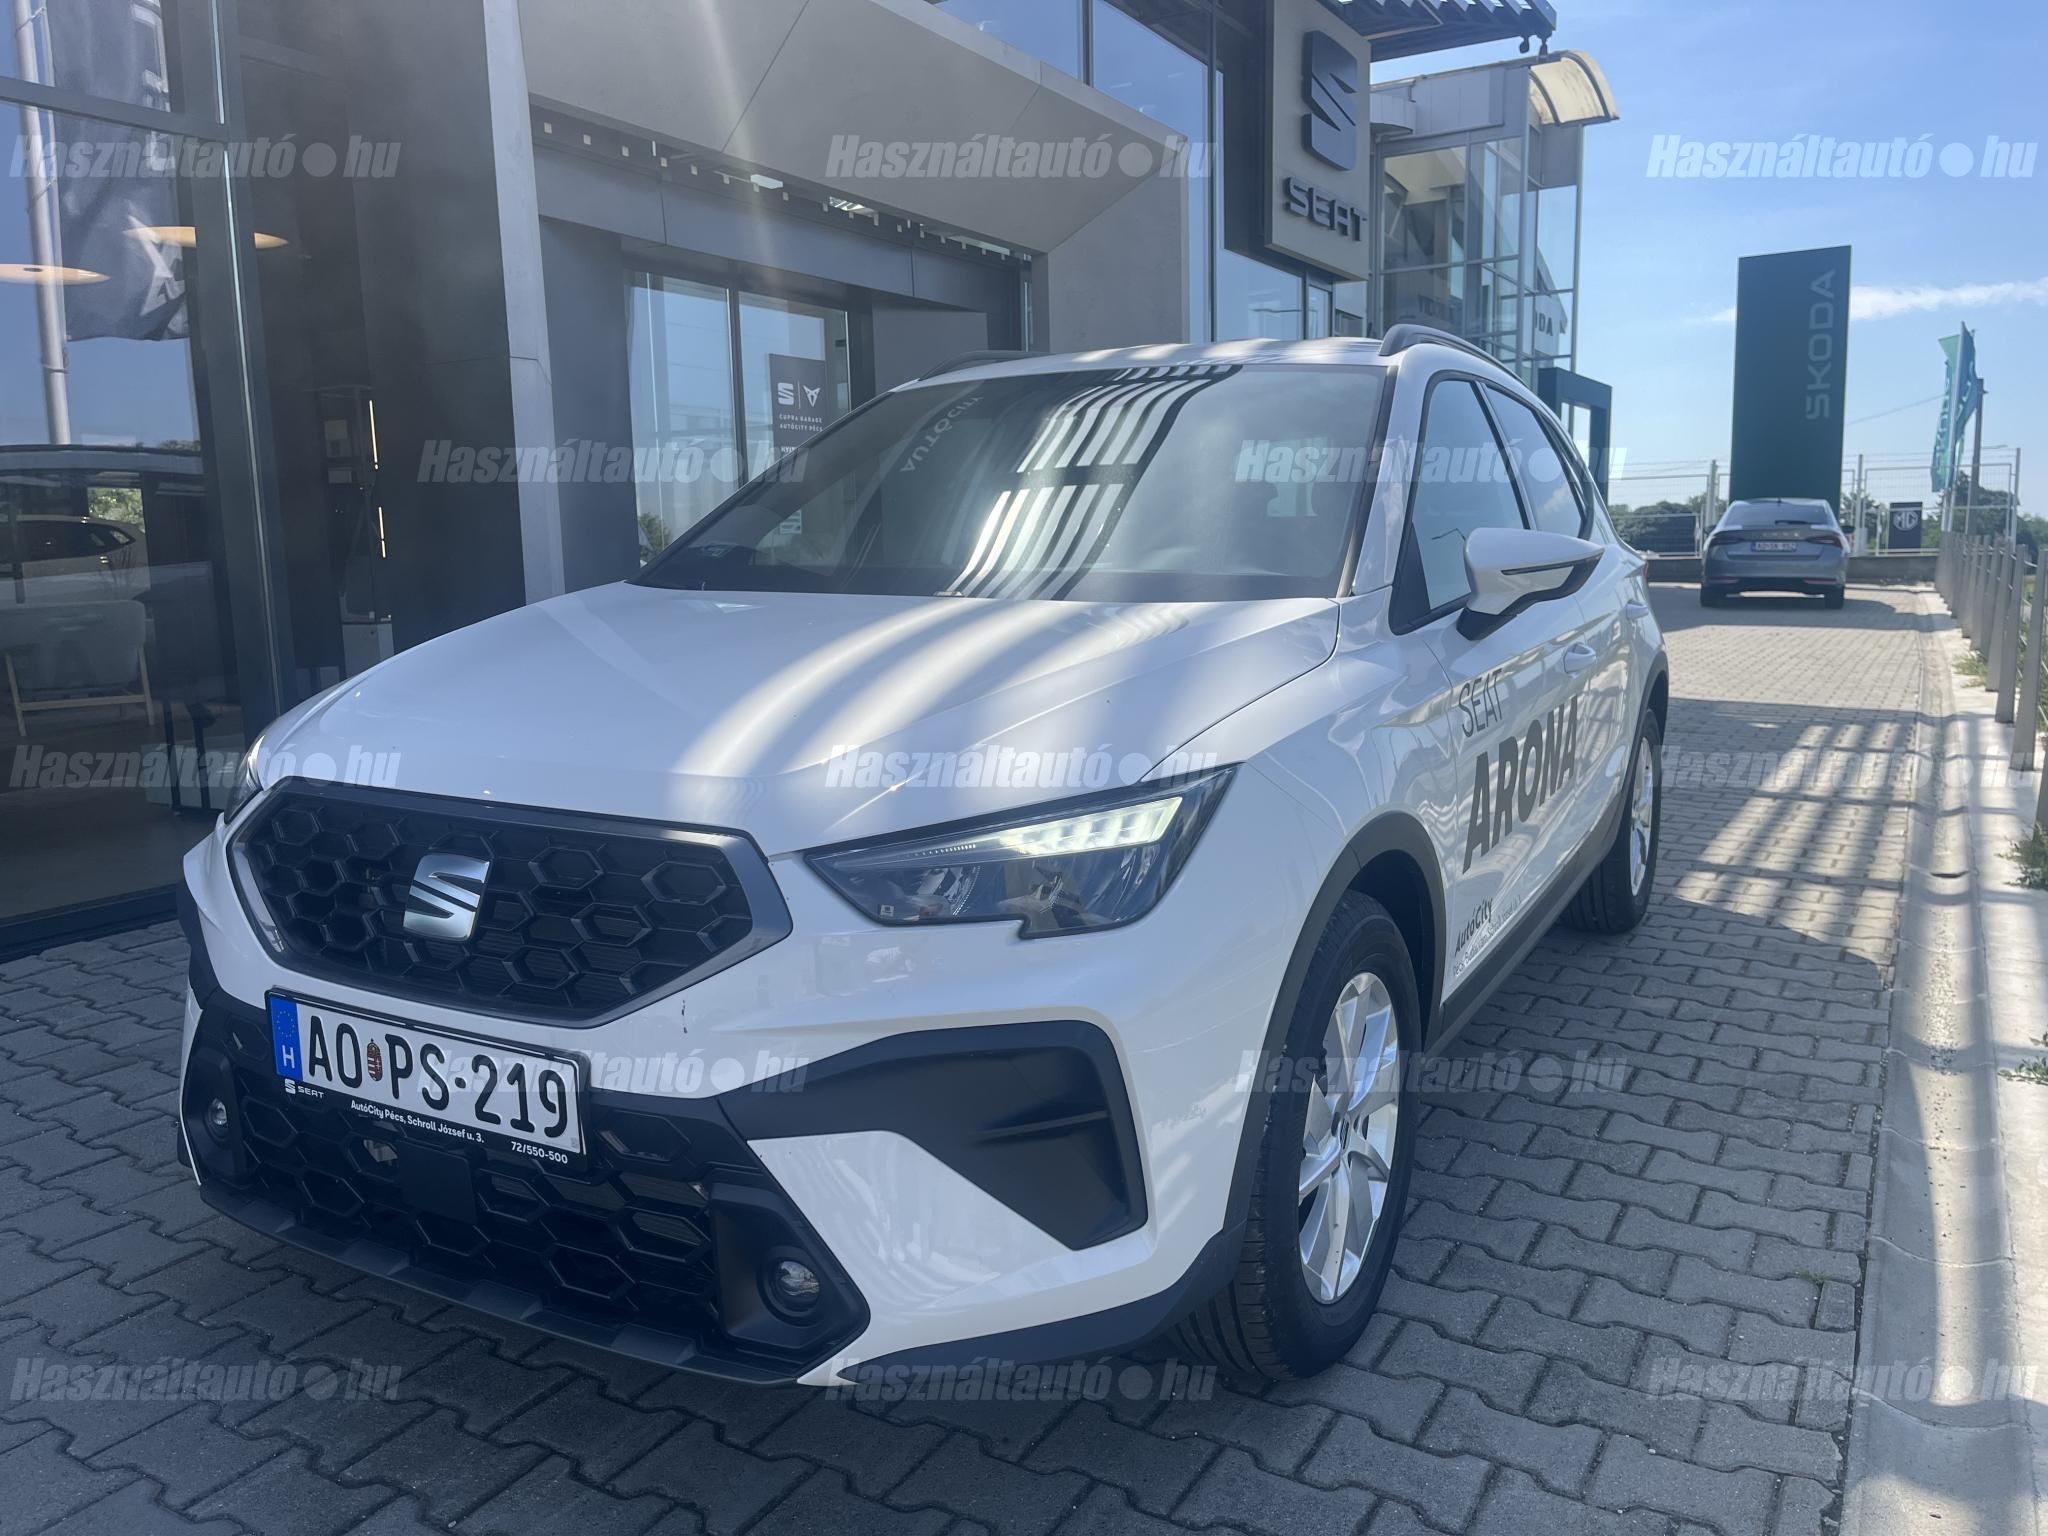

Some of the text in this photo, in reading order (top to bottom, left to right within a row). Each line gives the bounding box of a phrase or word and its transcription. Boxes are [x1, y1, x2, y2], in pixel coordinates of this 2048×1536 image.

[1284, 176, 1368, 241] SEAT
[779, 413, 799, 421] CUPRA
[779, 423, 808, 431] AUTÓCITY
[1458, 668, 1502, 738] SEAT
[1462, 694, 1578, 875] ARONA
[282, 1044, 296, 1069] H
[297, 1085, 324, 1099] SEAT
[351, 1100, 485, 1143] AutóCity Pécs, Schroll József u. 3.
[511, 1141, 568, 1164] 72/550-500
